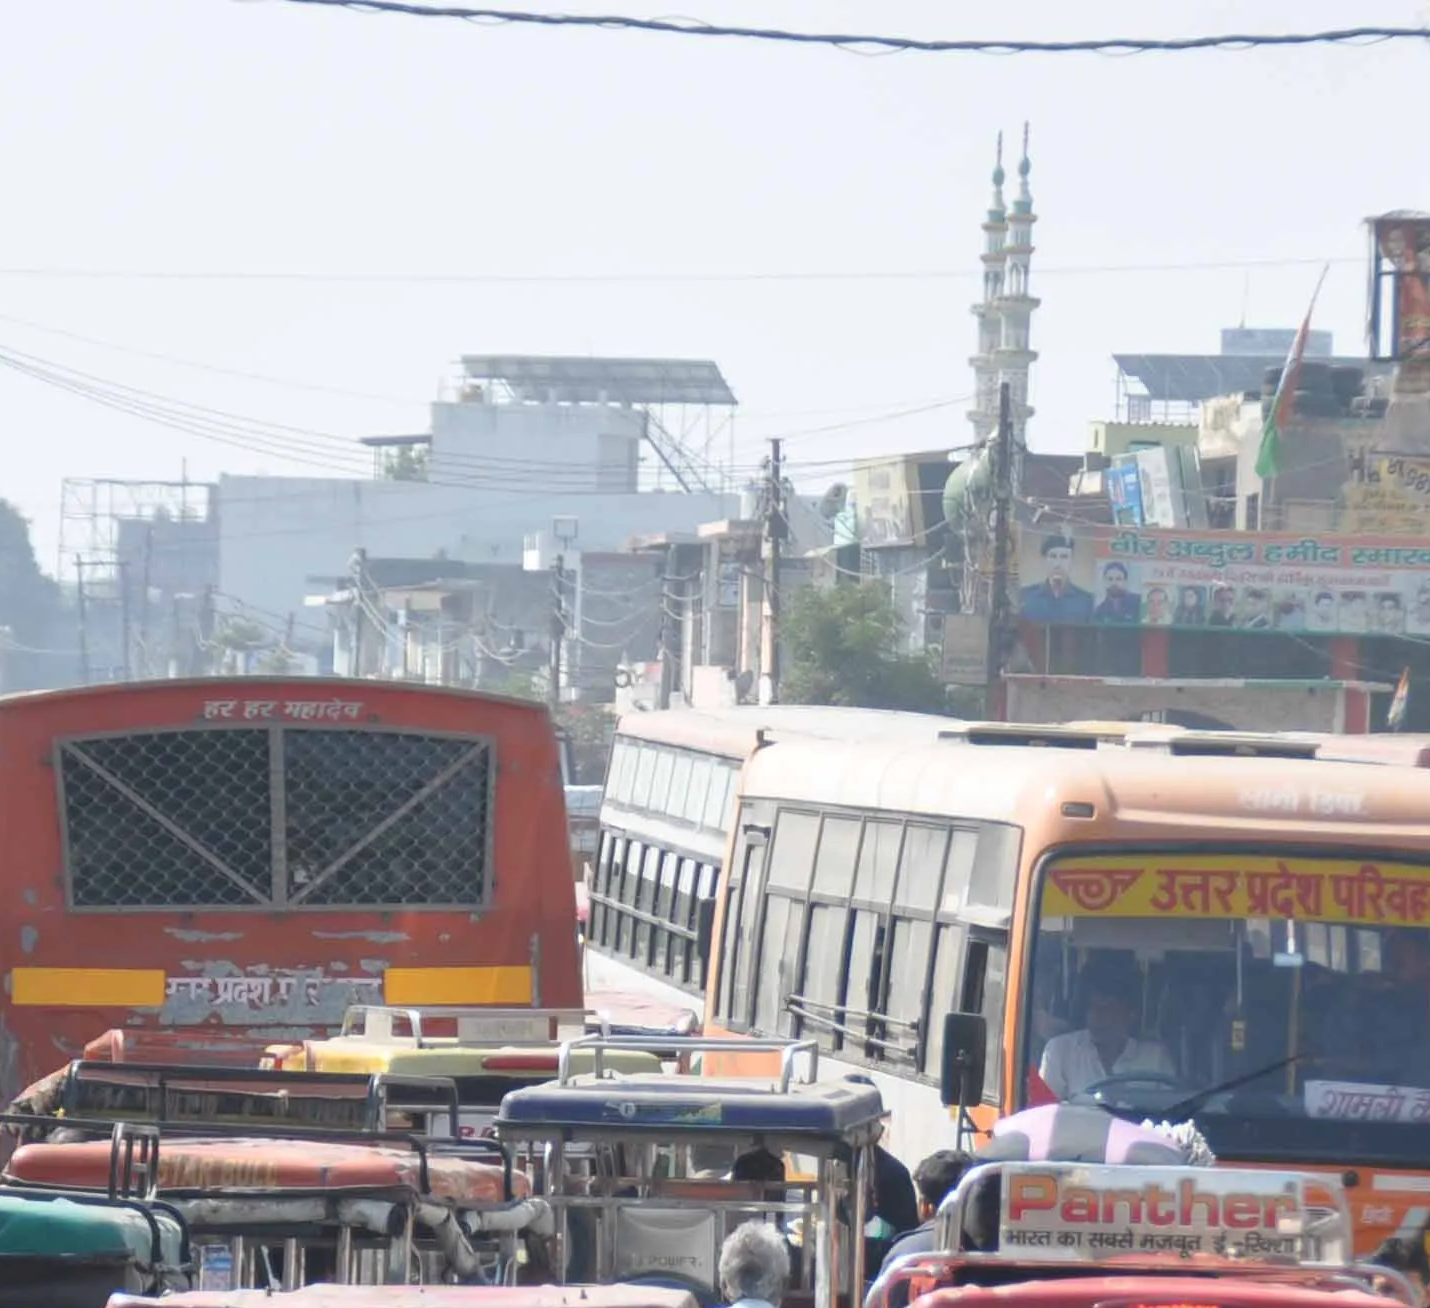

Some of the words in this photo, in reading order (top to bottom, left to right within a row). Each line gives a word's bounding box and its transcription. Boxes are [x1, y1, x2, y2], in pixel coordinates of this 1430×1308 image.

[1109, 532, 1158, 556] वीर
[1165, 541, 1254, 568] अब्दुल
[1263, 538, 1341, 564] हमीद
[204, 700, 237, 719] हर
[243, 700, 276, 719] हर
[284, 697, 362, 720] महादेव
[1150, 868, 1240, 913] उत्तर
[1244, 861, 1324, 919] प्रदेश
[1009, 1175, 1298, 1229] Panther
[1005, 1230, 1051, 1248] भारत
[1057, 1230, 1081, 1248] का
[1088, 1227, 1133, 1249] सबसे
[1139, 1233, 1202, 1258] मजबूत
